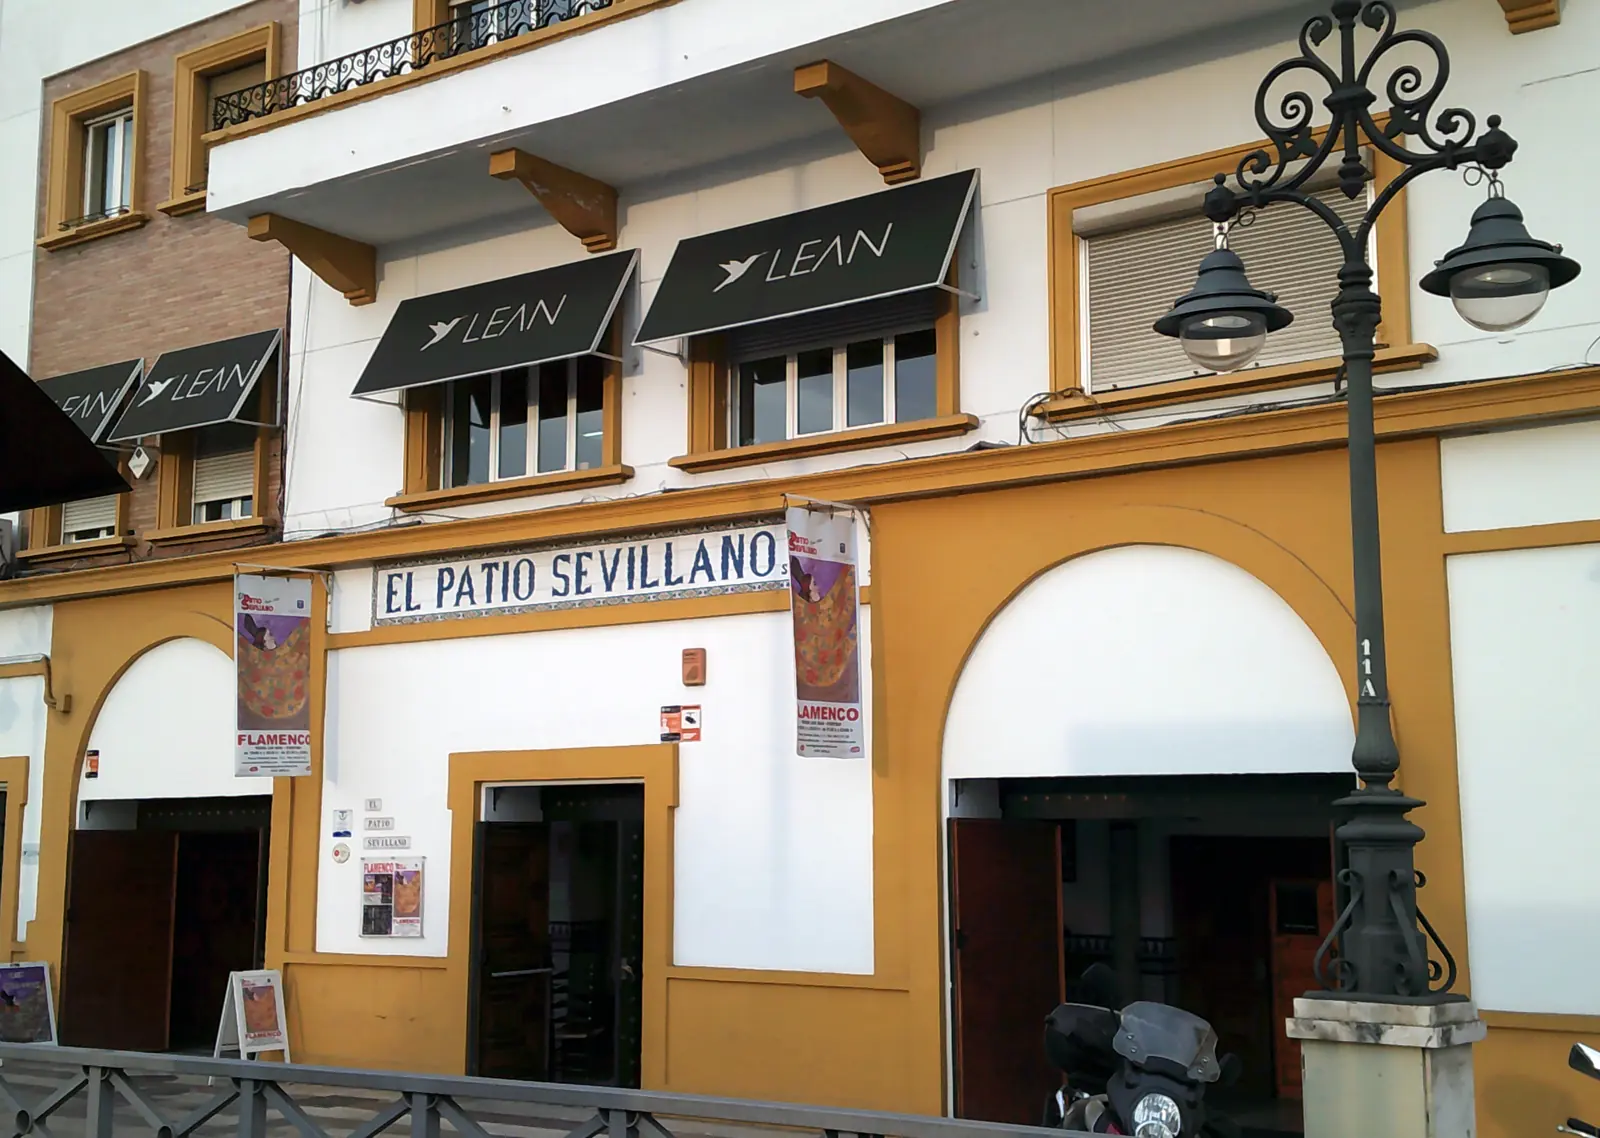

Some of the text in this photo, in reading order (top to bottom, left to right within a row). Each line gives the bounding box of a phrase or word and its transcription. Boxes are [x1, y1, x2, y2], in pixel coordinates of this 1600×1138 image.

[765, 222, 894, 283] LEAN
[462, 294, 567, 344] LEAN
[170, 360, 257, 401] LEAN
[56, 388, 120, 418] EAN
[385, 571, 421, 614] EL
[436, 557, 536, 610] PATIO
[551, 530, 776, 597] SEVILLANO
[798, 705, 859, 721] LAMENCO
[237, 734, 310, 746] FLAMENCO
[369, 801, 377, 809] EL
[368, 820, 391, 828] PATIO
[367, 838, 407, 847] SEVILLANO
